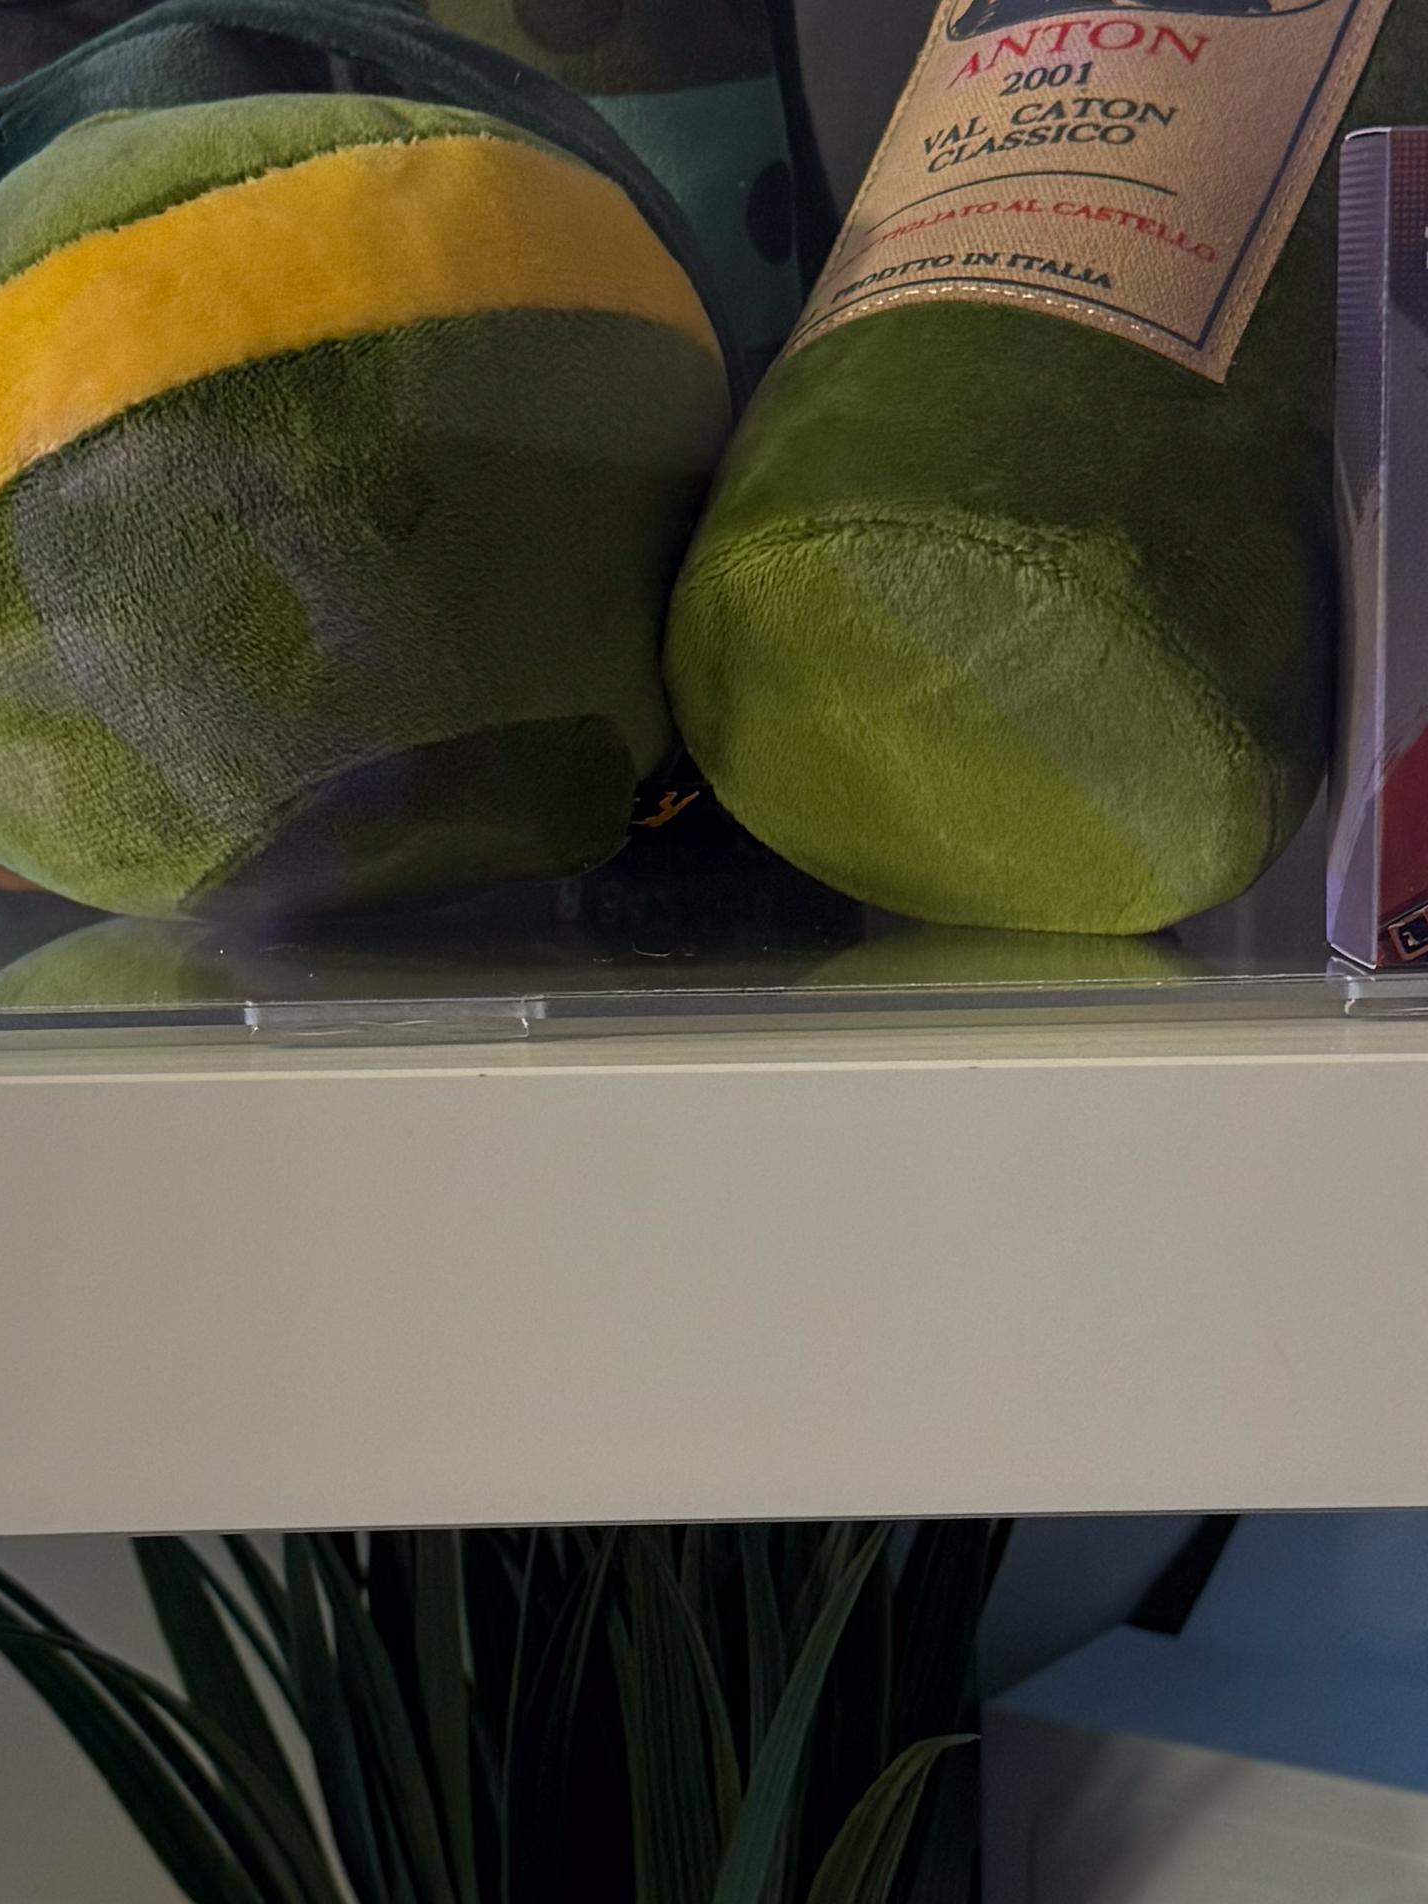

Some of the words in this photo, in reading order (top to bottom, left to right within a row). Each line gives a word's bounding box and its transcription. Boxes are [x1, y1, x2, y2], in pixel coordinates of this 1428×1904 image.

[946, 20, 1212, 90] ANTON
[998, 60, 1094, 97] 2001
[922, 116, 988, 156] VAL
[1010, 98, 1179, 127] CATON
[927, 123, 1136, 173] CLASSICO
[1002, 198, 1042, 213] AL
[1051, 201, 1216, 263] CASTELLO
[962, 252, 996, 266] IN
[1005, 253, 1112, 290] ITALIA
